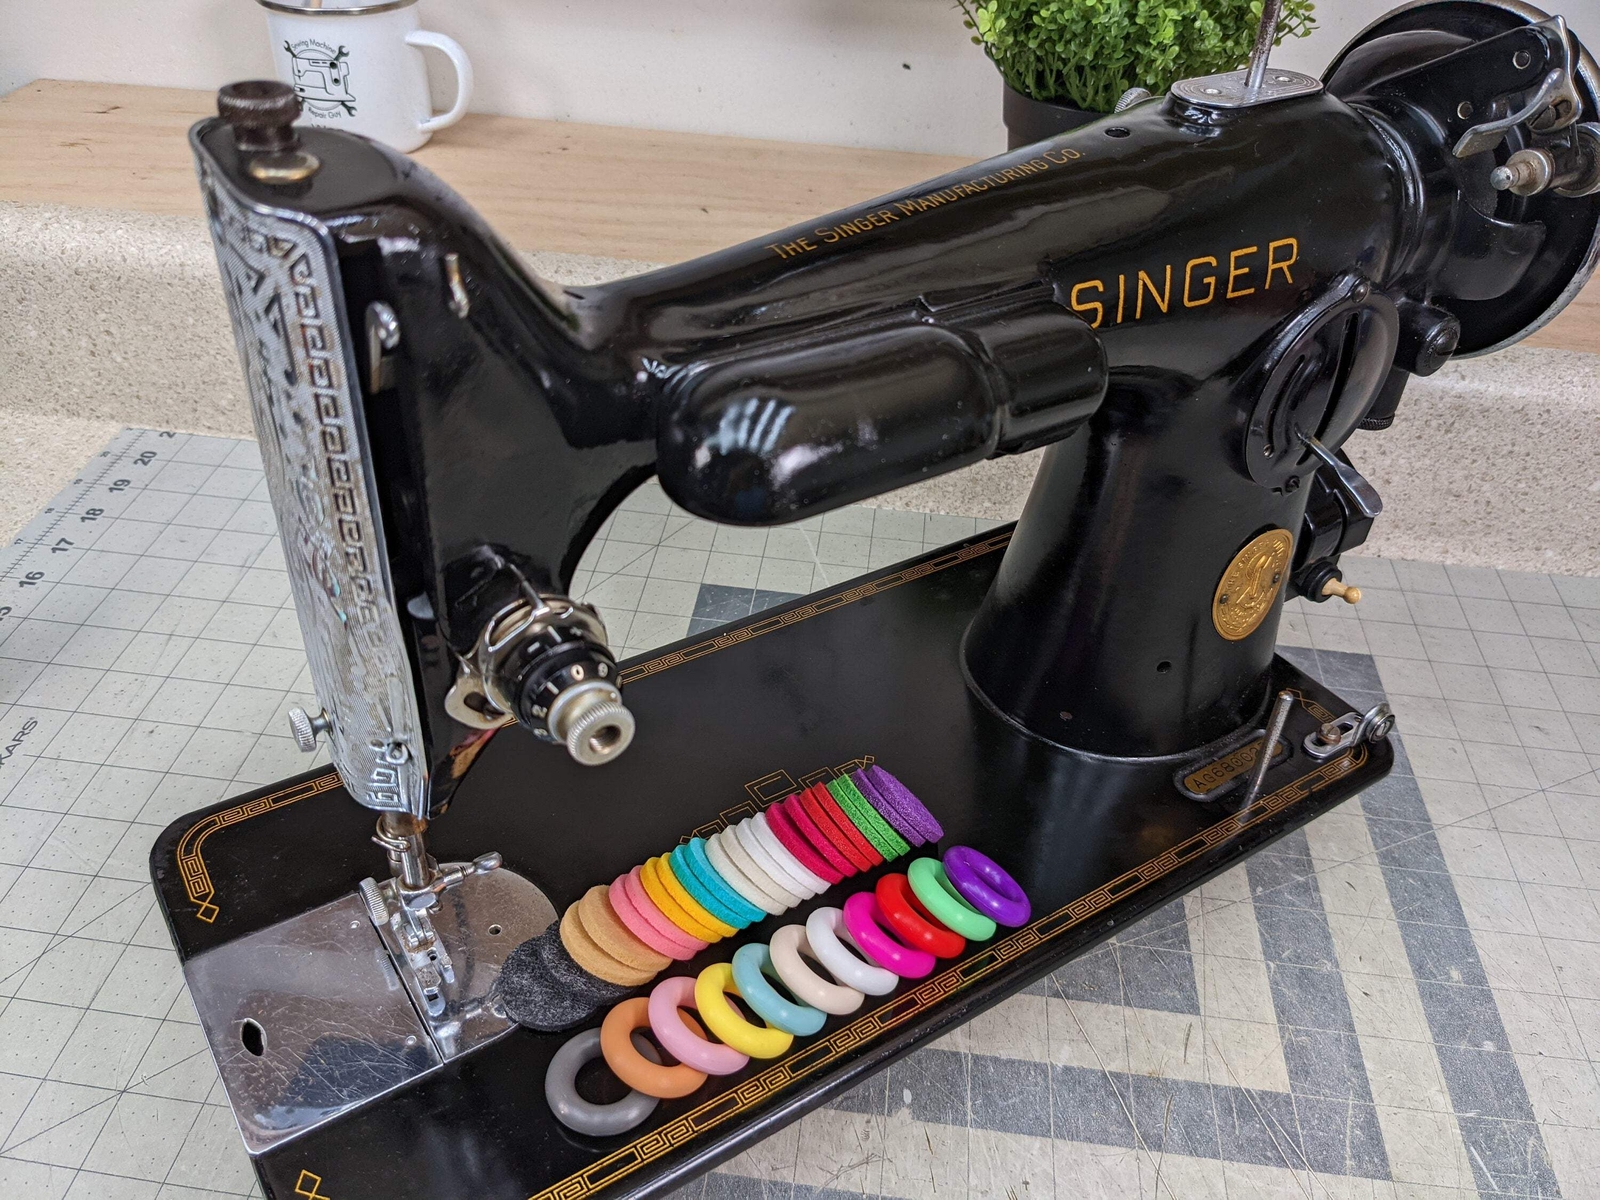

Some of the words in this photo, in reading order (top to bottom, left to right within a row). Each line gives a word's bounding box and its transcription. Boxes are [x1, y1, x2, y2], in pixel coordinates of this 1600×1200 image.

[309, 38, 337, 54] Machine
[765, 237, 818, 259] THE
[815, 210, 900, 244] SINGER
[895, 158, 1049, 217] MANUFACTURING
[1070, 237, 1298, 329] SINGER
[133, 451, 157, 466] 20
[108, 479, 131, 493] 19
[80, 508, 104, 523] 18
[51, 537, 75, 553] 17
[18, 571, 45, 588] 16
[1192, 741, 1263, 790] AG6800
